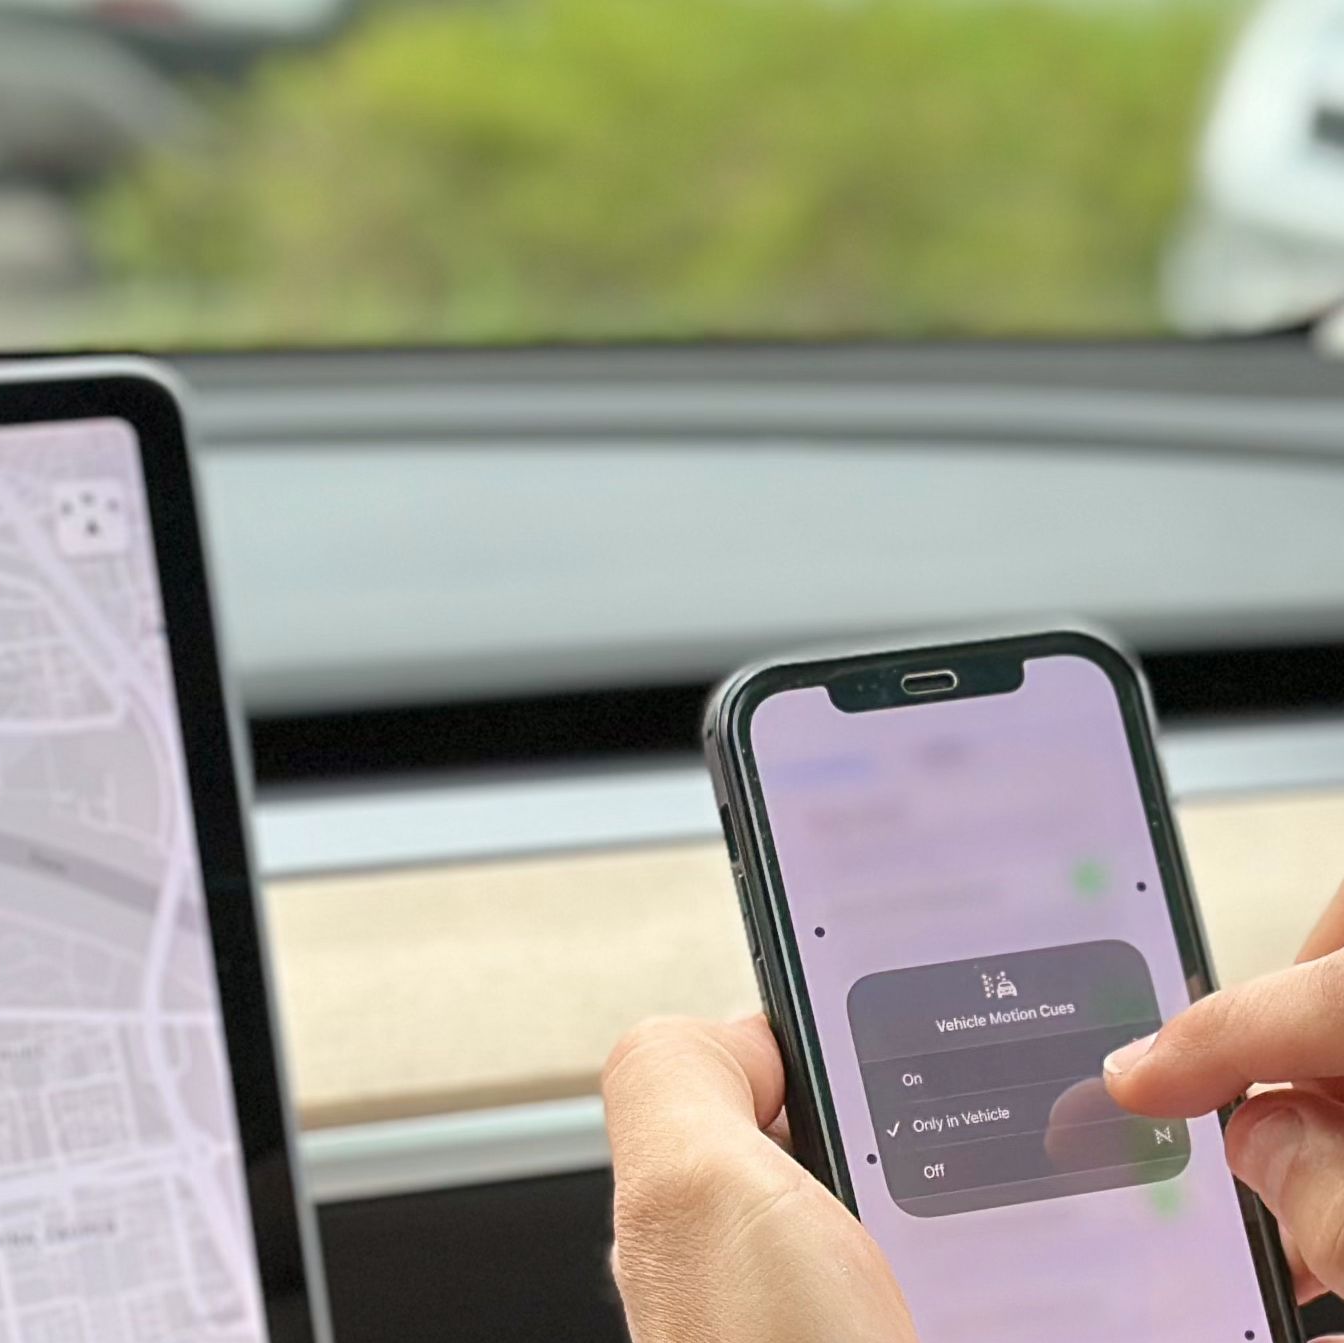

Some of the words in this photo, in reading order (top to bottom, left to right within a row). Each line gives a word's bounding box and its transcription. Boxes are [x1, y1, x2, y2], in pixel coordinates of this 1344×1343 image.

[936, 1014, 987, 1033] Vehicle
[989, 1007, 1038, 1026] Motion
[1039, 1002, 1076, 1019] Cues
[902, 1073, 923, 1087] On
[912, 1117, 943, 1133] Only
[946, 1114, 959, 1129] in
[961, 1107, 1011, 1126] Vehicle
[923, 1163, 946, 1180] Off
